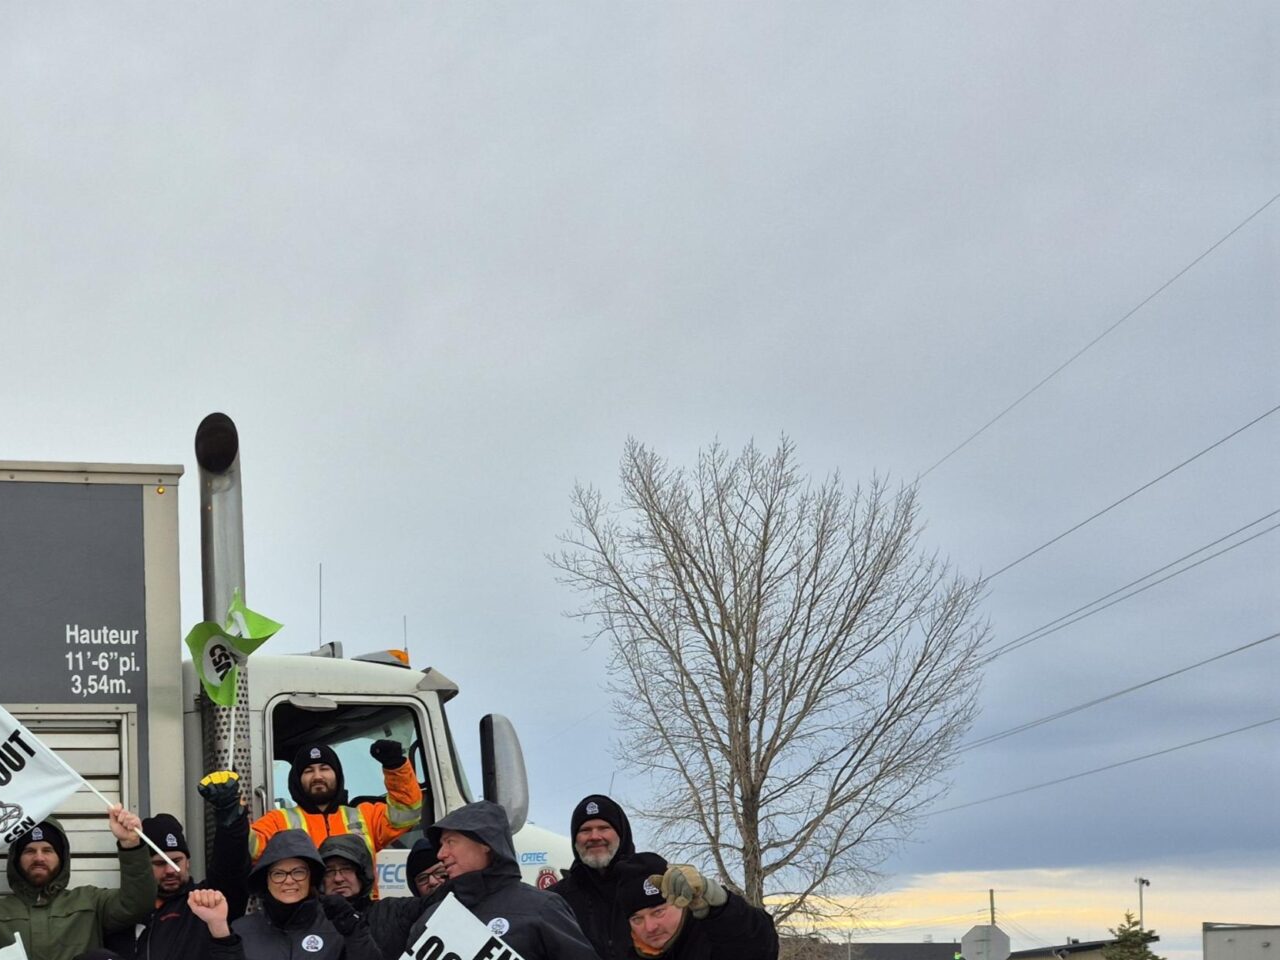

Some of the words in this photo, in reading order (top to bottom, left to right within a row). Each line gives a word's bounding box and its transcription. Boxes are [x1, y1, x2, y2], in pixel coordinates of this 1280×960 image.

[65, 624, 139, 644] Hauteur
[71, 674, 131, 697] 3,54m.
[4, 816, 36, 844] CSN
[376, 863, 406, 883] TEC
